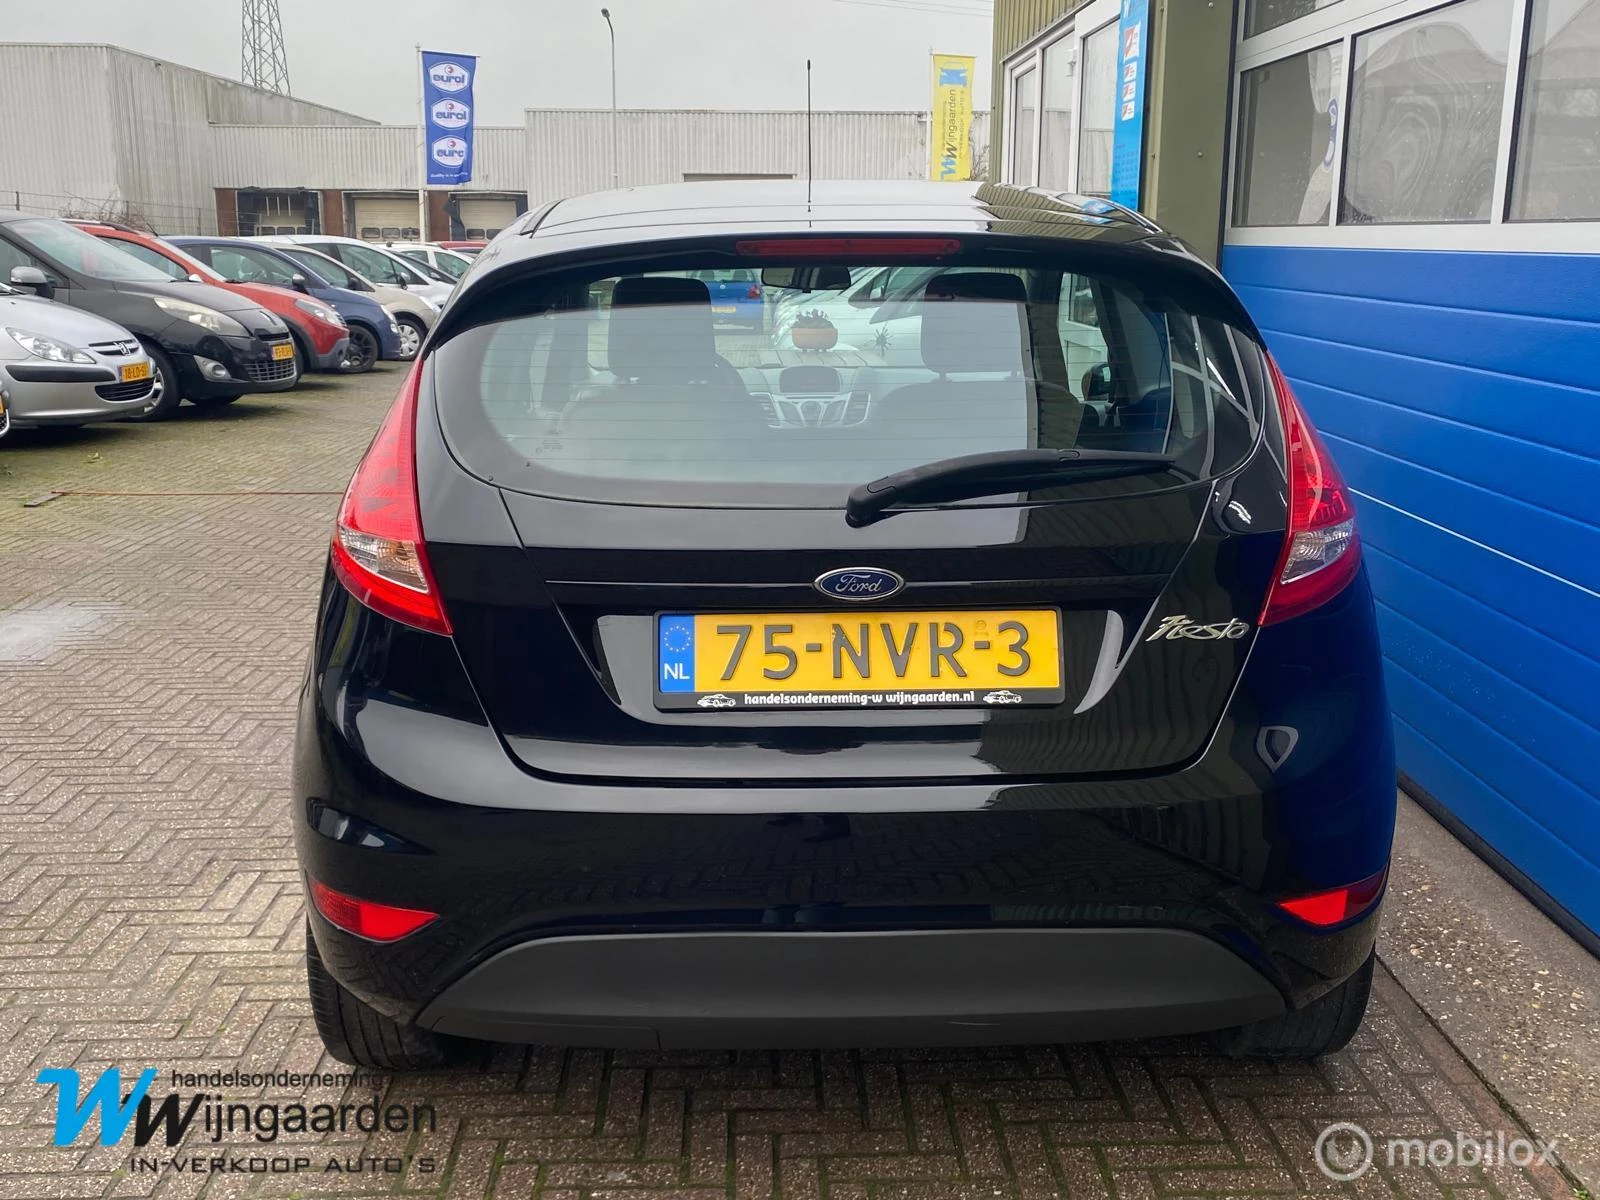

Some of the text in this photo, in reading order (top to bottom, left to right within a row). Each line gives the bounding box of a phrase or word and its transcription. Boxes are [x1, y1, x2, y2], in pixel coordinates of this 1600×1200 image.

[432, 74, 465, 83] eurol
[435, 110, 467, 120] eurol
[436, 148, 464, 158] euro
[835, 573, 883, 592] Ford
[1145, 615, 1250, 642] Fiesta
[716, 619, 1032, 681] 75-NVR-3
[663, 662, 691, 681] NL
[744, 690, 975, 706] handelsonderneming-w wijngaarden.nl
